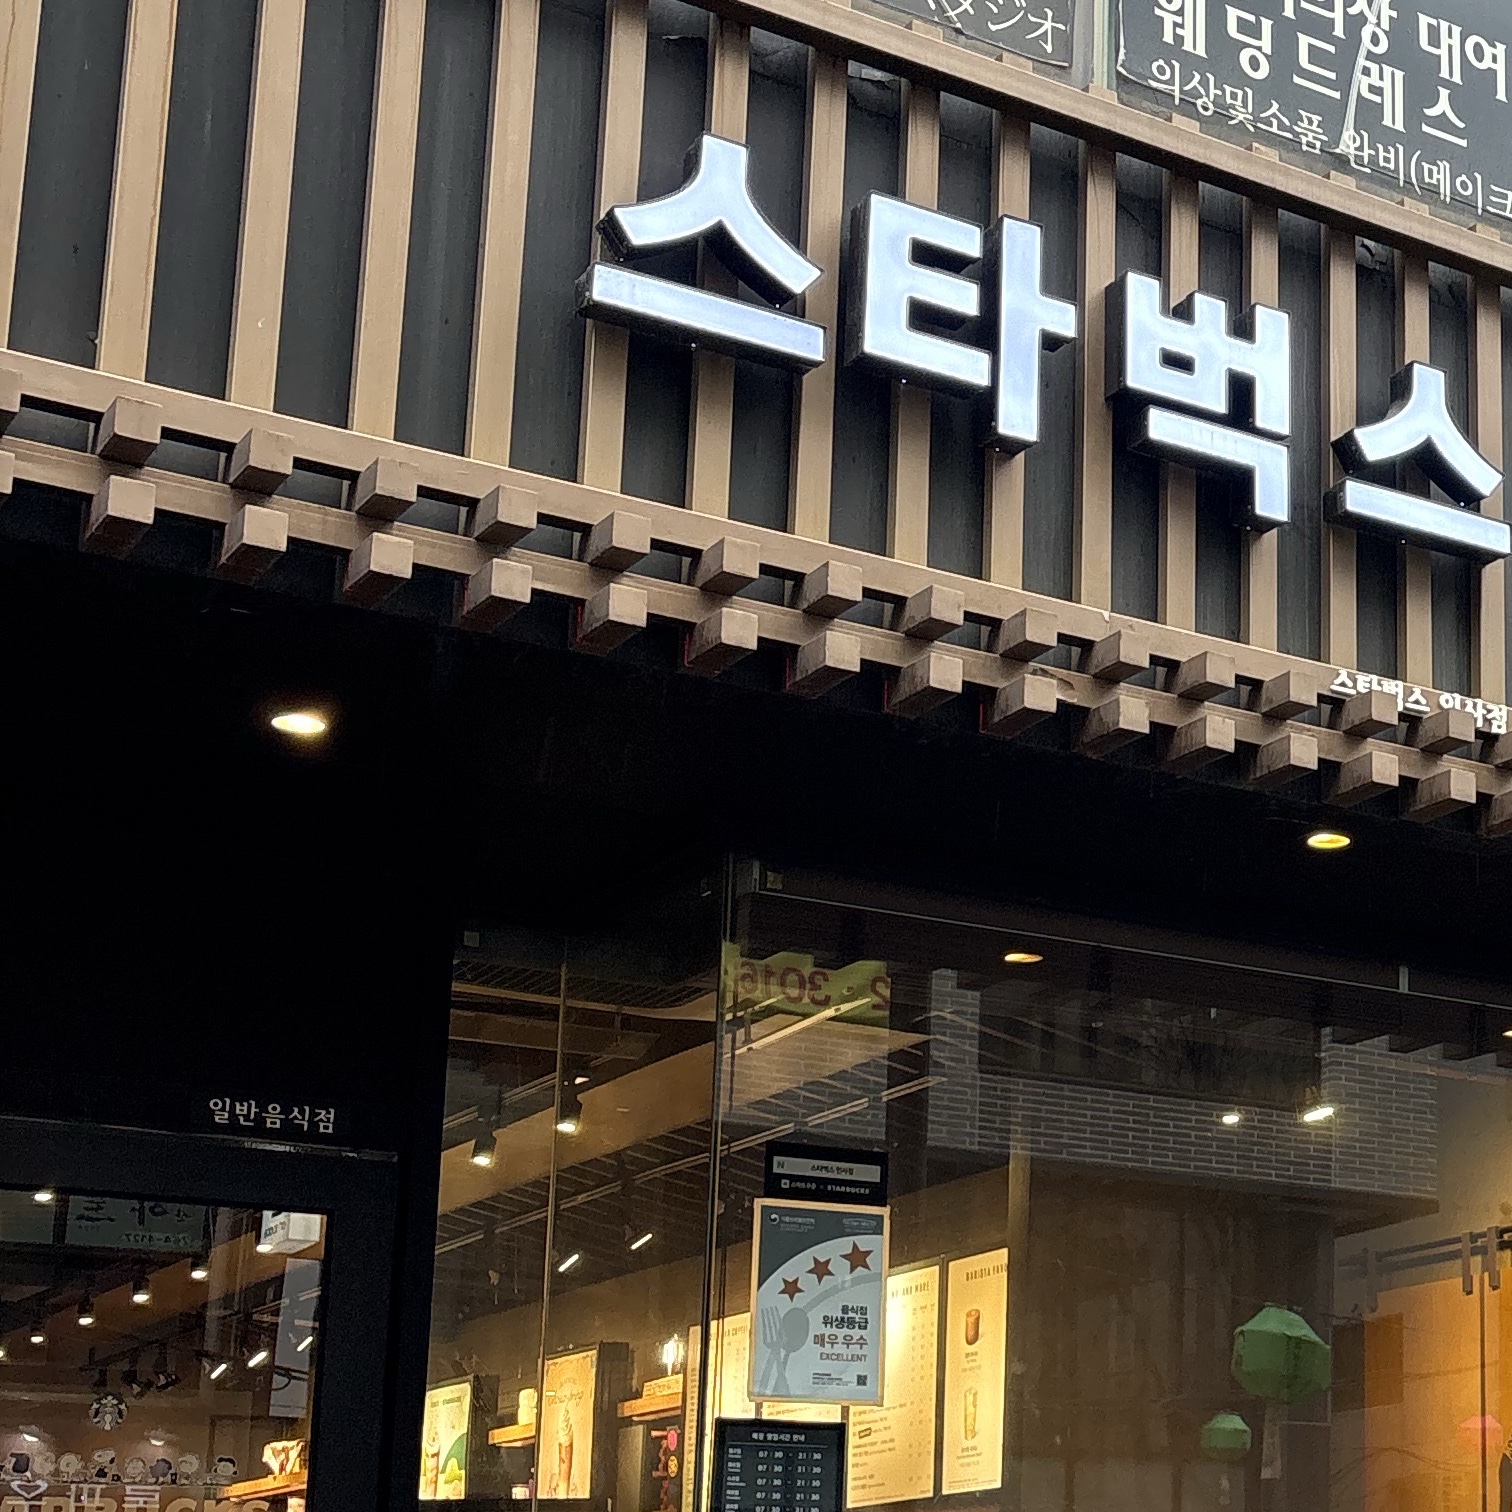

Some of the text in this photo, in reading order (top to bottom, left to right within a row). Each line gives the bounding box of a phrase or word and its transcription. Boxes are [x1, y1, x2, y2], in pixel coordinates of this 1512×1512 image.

[927, 0, 1066, 53] ジオ
[585, 132, 1512, 558] 스타벅스
[209, 1098, 336, 1134] 일반음식점
[820, 1352, 868, 1362] EXCELLENT
